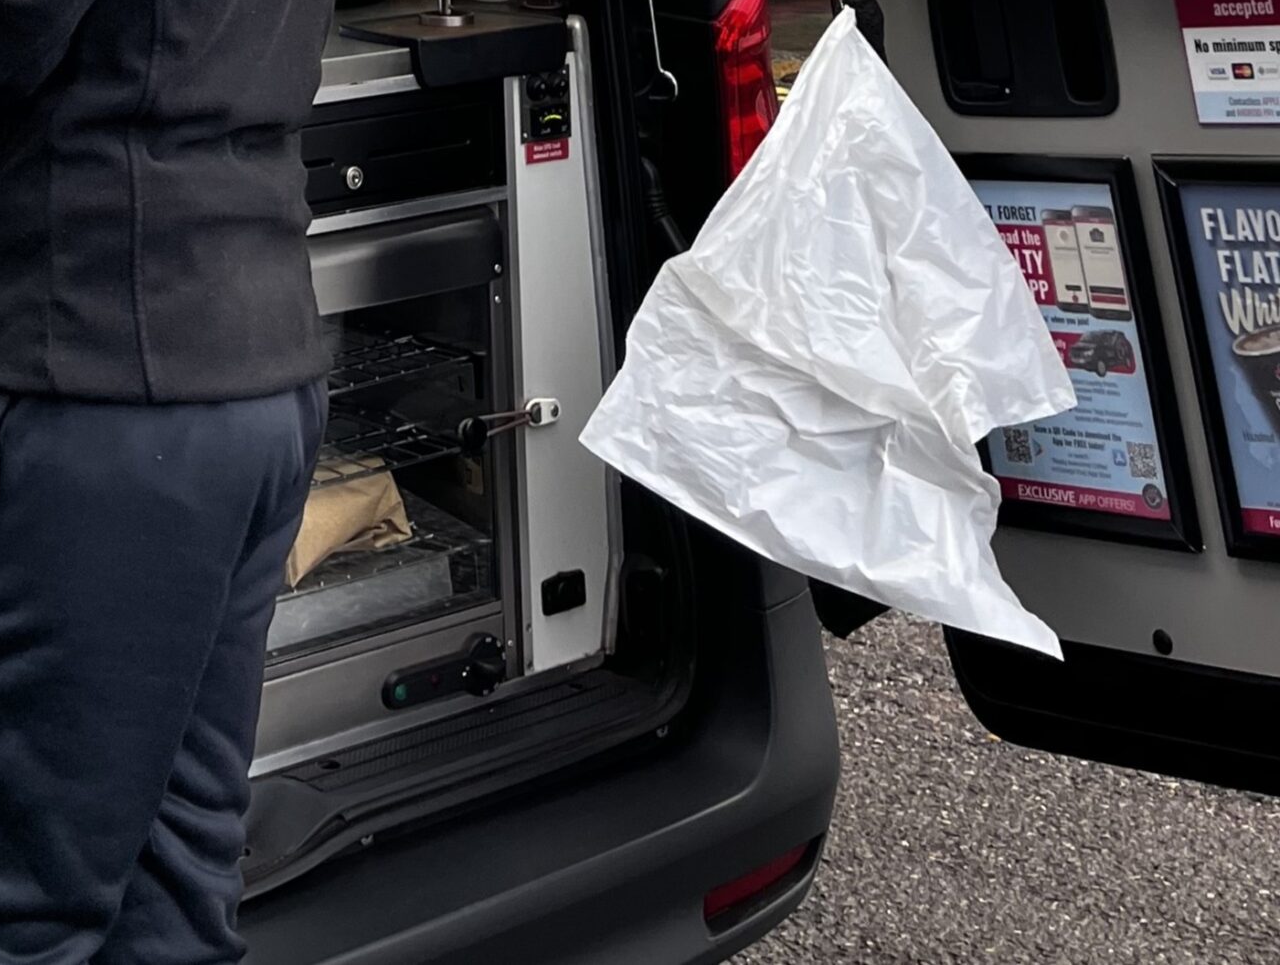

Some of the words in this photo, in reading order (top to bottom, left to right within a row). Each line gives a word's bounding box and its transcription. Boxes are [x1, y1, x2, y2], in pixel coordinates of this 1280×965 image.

[1194, 38, 1209, 53] No
[1212, 37, 1266, 53] minimum
[997, 205, 1036, 221] FORGET
[1021, 229, 1041, 245] the
[1217, 250, 1280, 284] FLAT
[1028, 279, 1049, 300] PP
[1219, 286, 1280, 335] Whi
[1018, 484, 1076, 504] EXCLUSIVE
[1078, 493, 1095, 505] APP
[1097, 495, 1135, 512] OFFERS!
